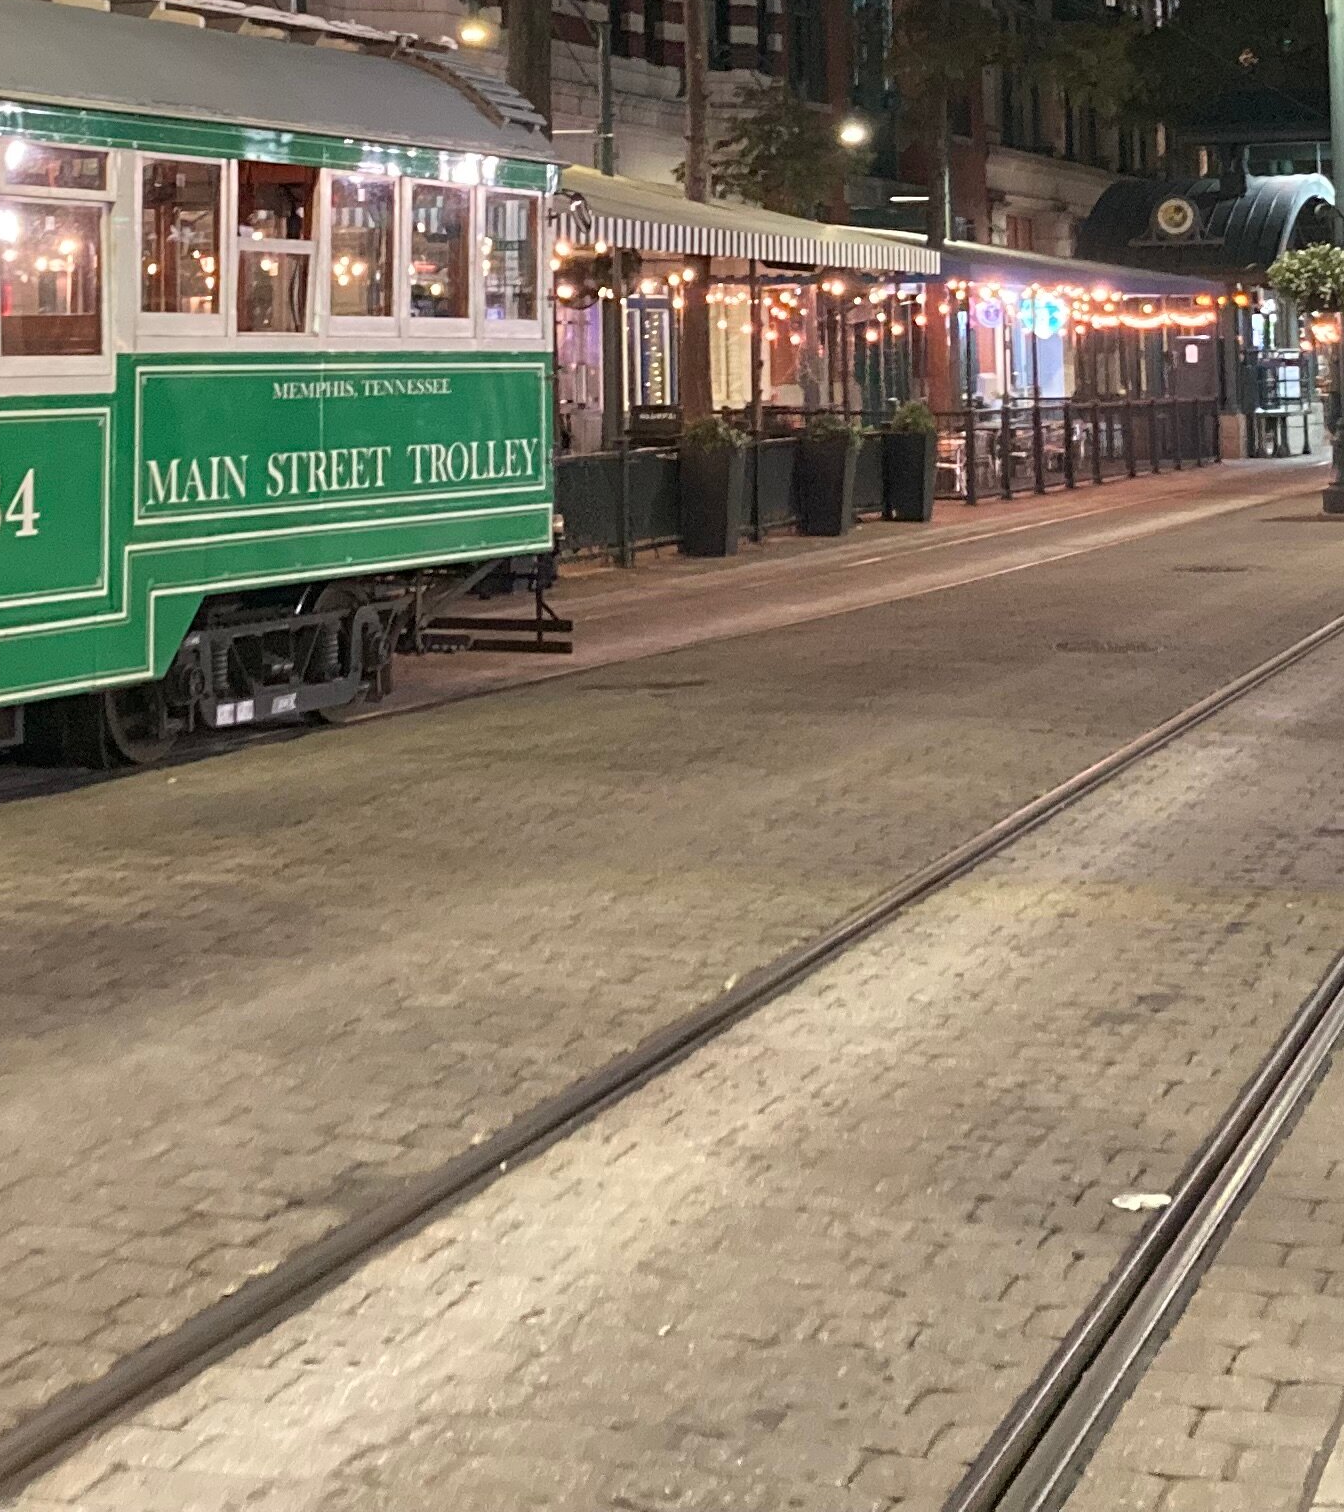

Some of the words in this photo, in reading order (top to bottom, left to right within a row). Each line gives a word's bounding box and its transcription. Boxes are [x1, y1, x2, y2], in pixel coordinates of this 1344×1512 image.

[273, 381, 357, 400] MEMPHIS,
[363, 377, 451, 397] TENNESSEE
[146, 454, 248, 506] MAIN
[265, 446, 390, 498] STREET
[407, 437, 538, 484] TROLLEY
